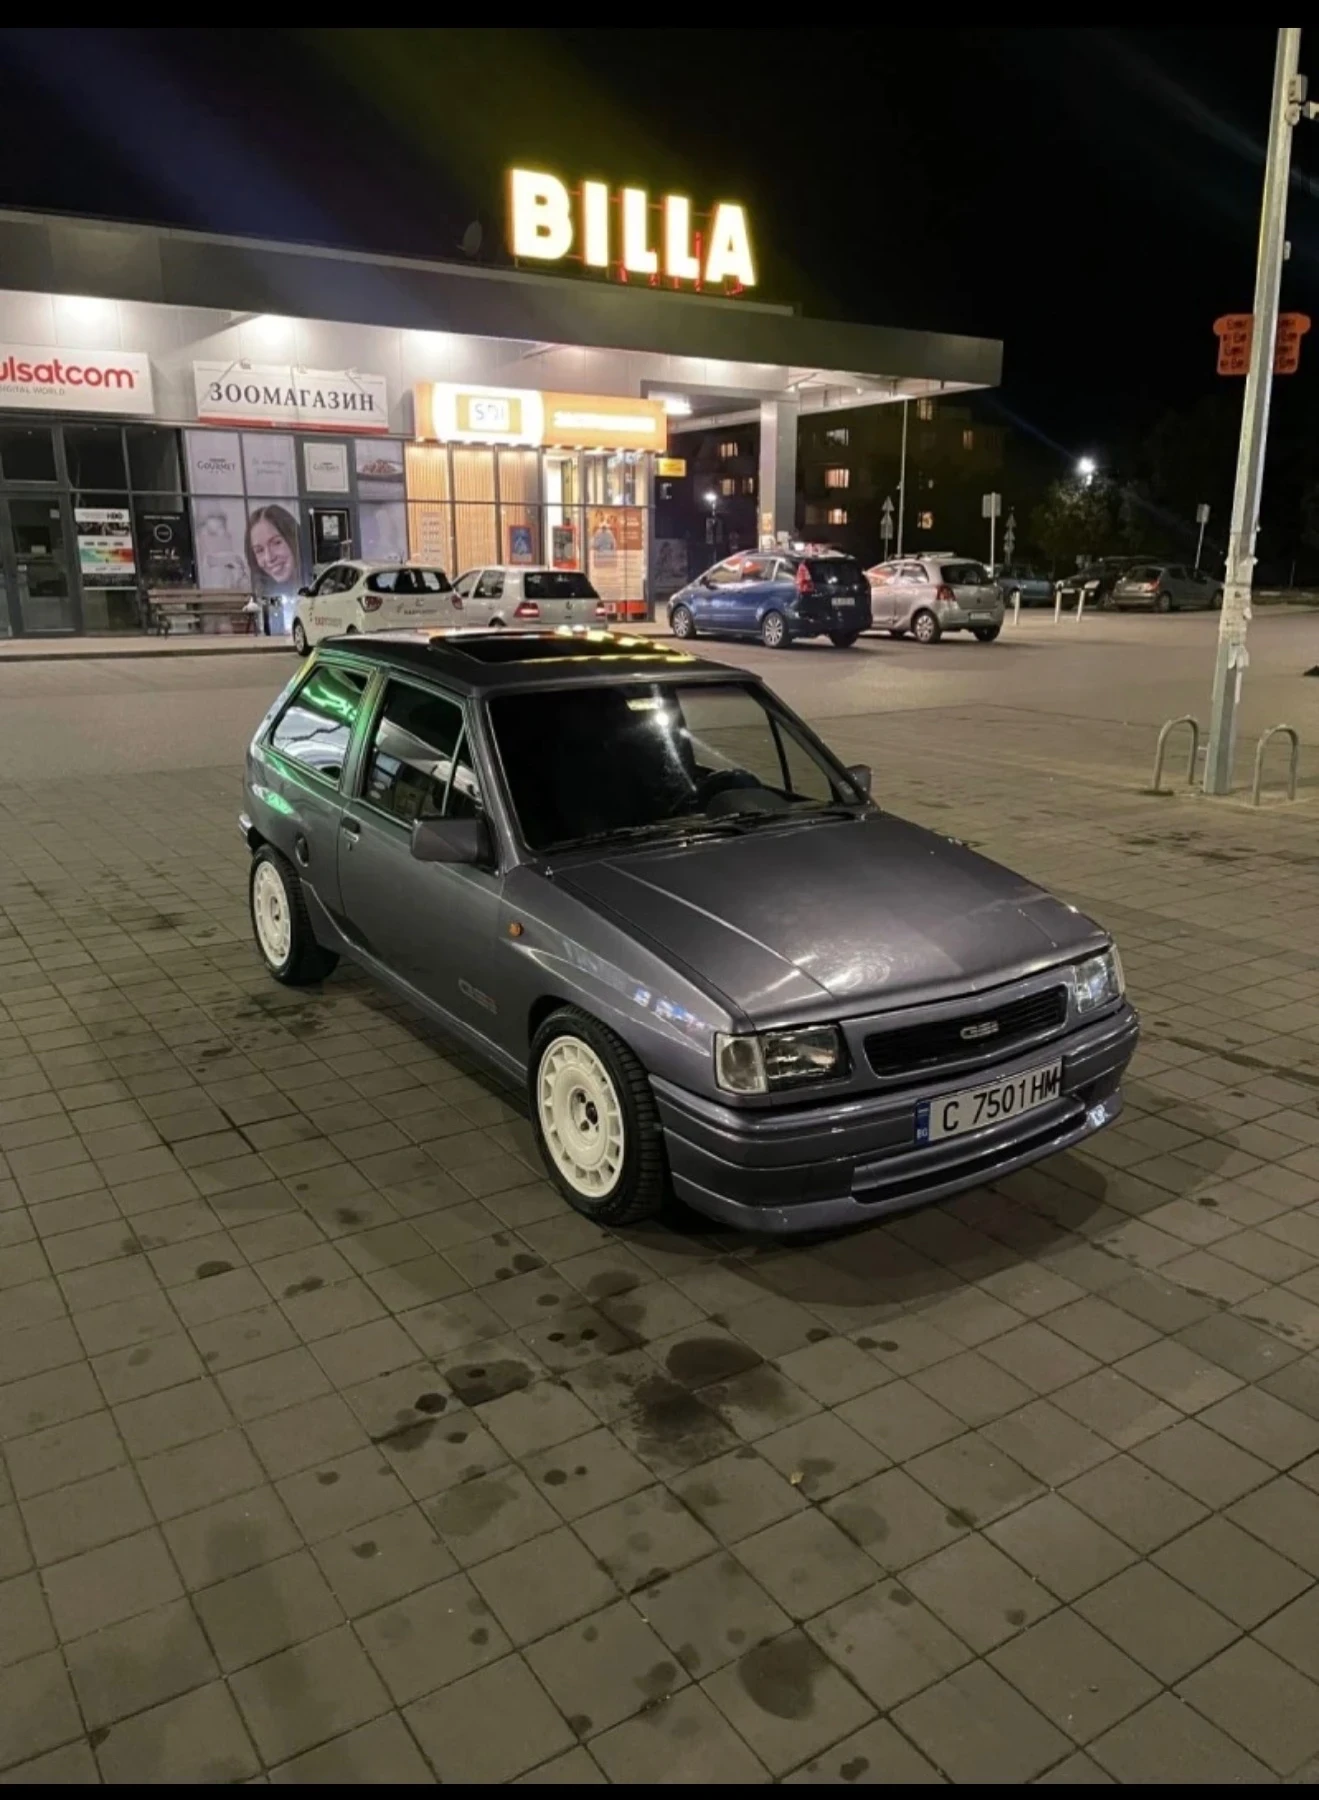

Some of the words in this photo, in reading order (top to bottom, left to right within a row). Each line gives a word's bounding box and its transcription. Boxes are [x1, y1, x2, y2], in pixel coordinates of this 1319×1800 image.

[510, 168, 756, 286] BILLA
[33, 386, 65, 396] WORLD
[209, 382, 374, 411] ЗООМАГАЗИН
[942, 1101, 959, 1132] C
[972, 1079, 1026, 1125] 7501
[916, 1128, 928, 1139] BG
